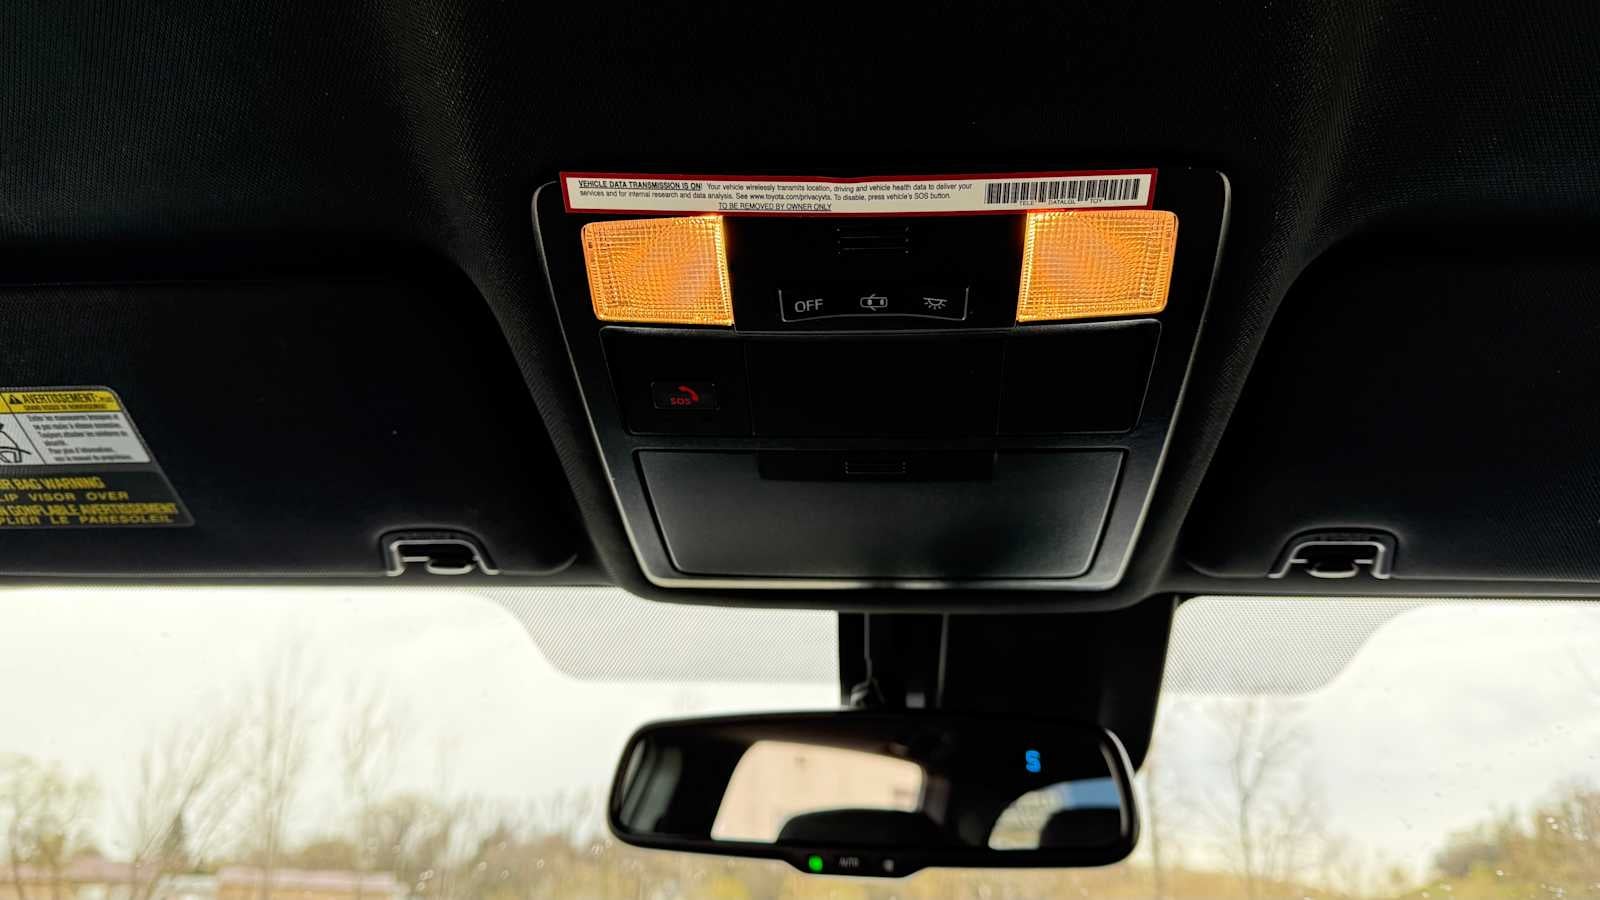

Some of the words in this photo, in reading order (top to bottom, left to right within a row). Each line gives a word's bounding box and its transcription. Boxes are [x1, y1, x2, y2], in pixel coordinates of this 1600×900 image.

[578, 180, 608, 189] VEHICLE
[609, 181, 627, 189] DATA
[629, 181, 680, 190] TRANSMISSION
[682, 182, 689, 190] IS
[746, 183, 775, 192] wirelessly
[807, 184, 832, 192] location,
[834, 185, 854, 193] driving
[856, 184, 868, 192] and
[892, 183, 912, 191] health
[936, 182, 957, 190] deliver
[958, 183, 973, 192] your
[580, 189, 605, 197] services
[606, 189, 618, 197] and
[652, 190, 679, 198] research
[680, 191, 691, 199] and
[692, 191, 706, 199] data
[708, 191, 733, 200] analysis.
[736, 192, 748, 200] See
[834, 193, 842, 201] To
[868, 194, 885, 202] press
[886, 192, 913, 200] vehicle's
[914, 192, 929, 200] SOS
[719, 202, 728, 210] TO
[730, 202, 739, 210] BE
[740, 202, 774, 210] REMOVED
[775, 202, 785, 210] BY
[786, 203, 812, 211] OWNER
[813, 203, 832, 211] ONLY
[795, 299, 824, 313] OFF
[12, 478, 42, 490] BAG
[41, 476, 105, 489] WARNING
[27, 492, 77, 502] VISOR
[86, 491, 128, 501] OVER
[50, 515, 70, 525] LE
[79, 514, 174, 525] PARESOLEIL
[1025, 749, 1041, 773] S
